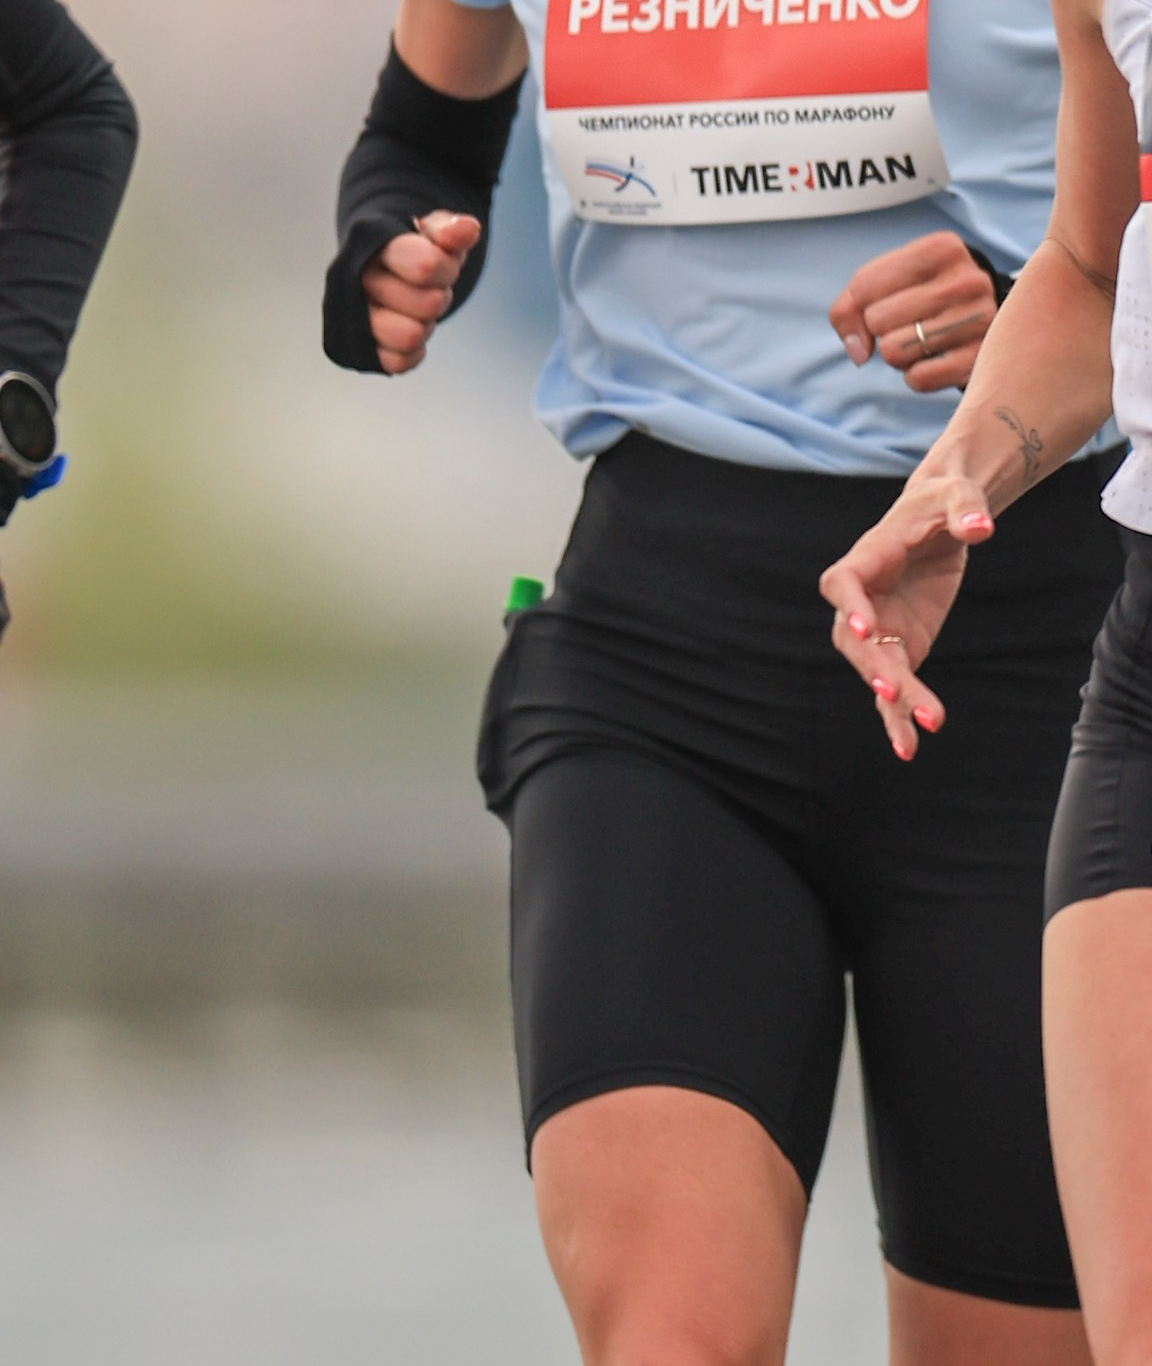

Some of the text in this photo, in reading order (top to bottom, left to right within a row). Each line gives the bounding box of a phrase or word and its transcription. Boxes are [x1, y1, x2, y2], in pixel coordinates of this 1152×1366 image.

[578, 105, 896, 132] ЧЕМПИОНАТ РОССИИ ПО МАРАФОНУ
